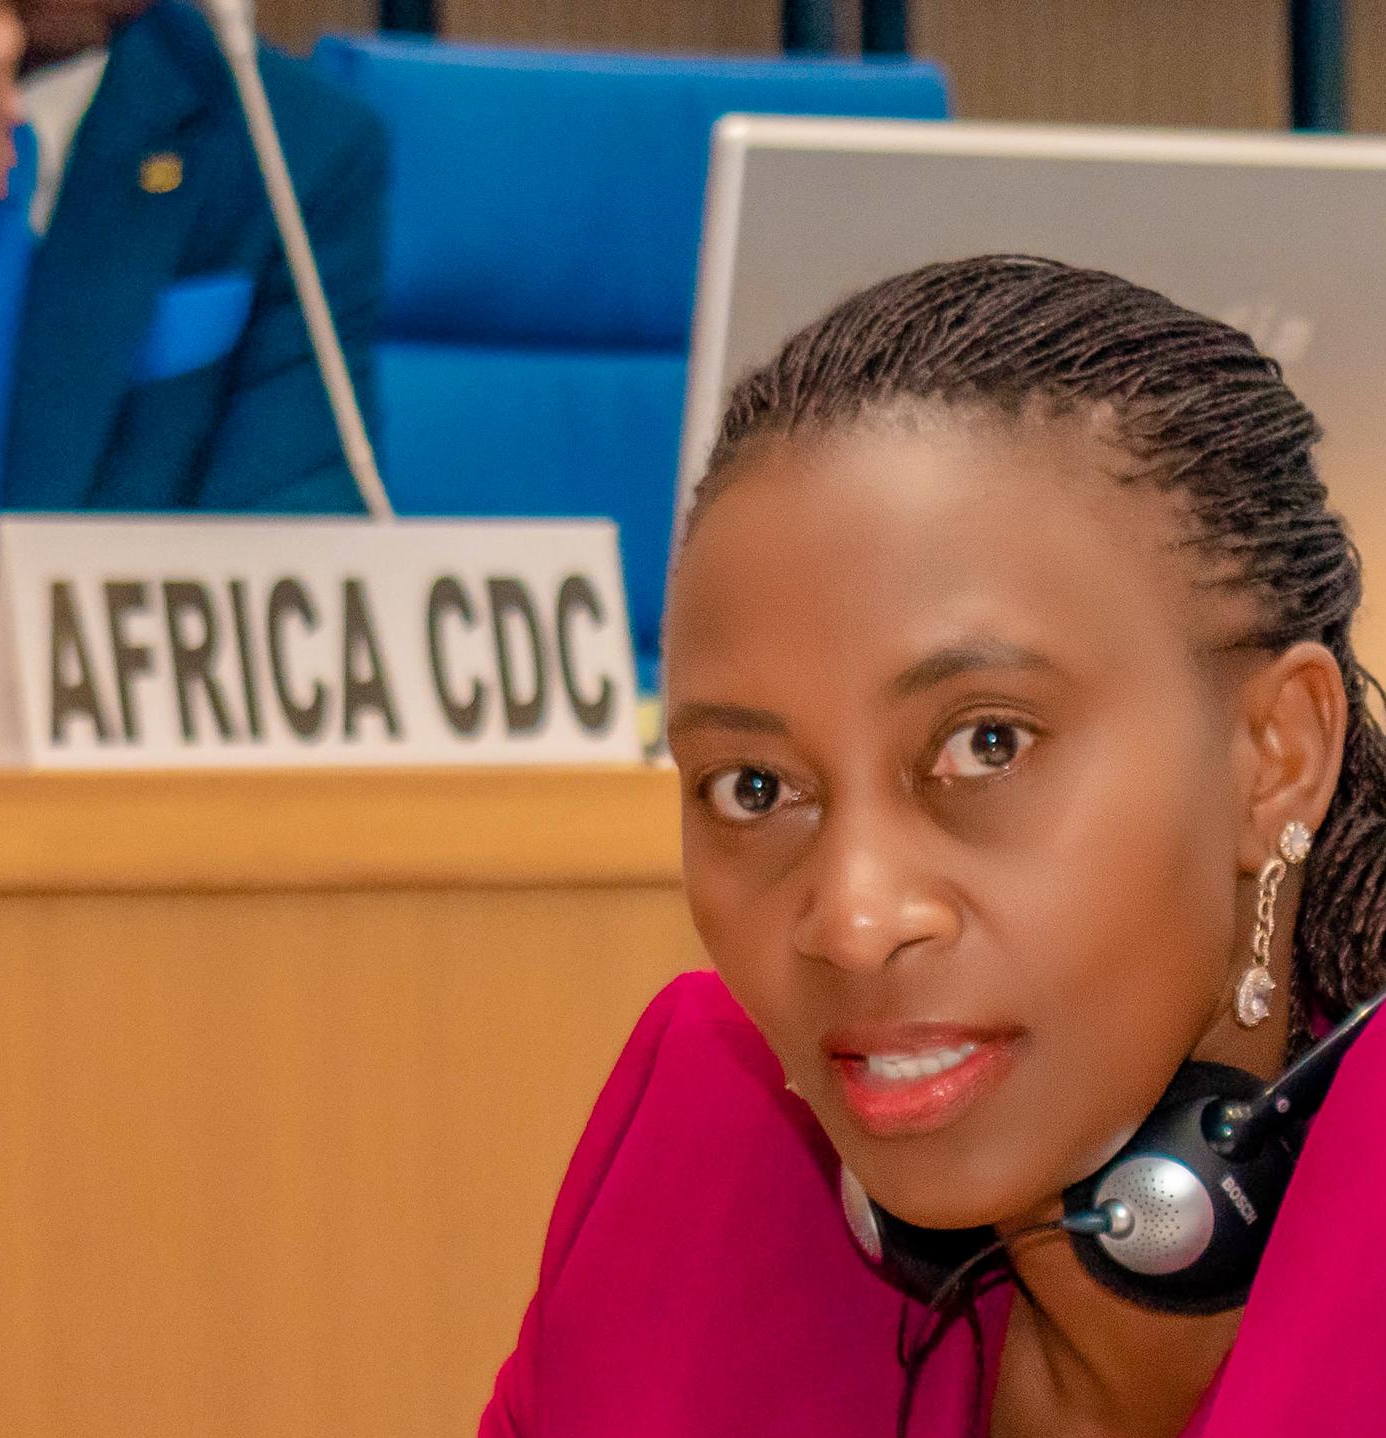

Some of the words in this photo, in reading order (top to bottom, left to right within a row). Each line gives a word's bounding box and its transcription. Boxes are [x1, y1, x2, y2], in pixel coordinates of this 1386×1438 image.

[48, 577, 404, 744] AFRICA
[427, 574, 617, 739] CDC
[1221, 1175, 1258, 1226] BOSCH
